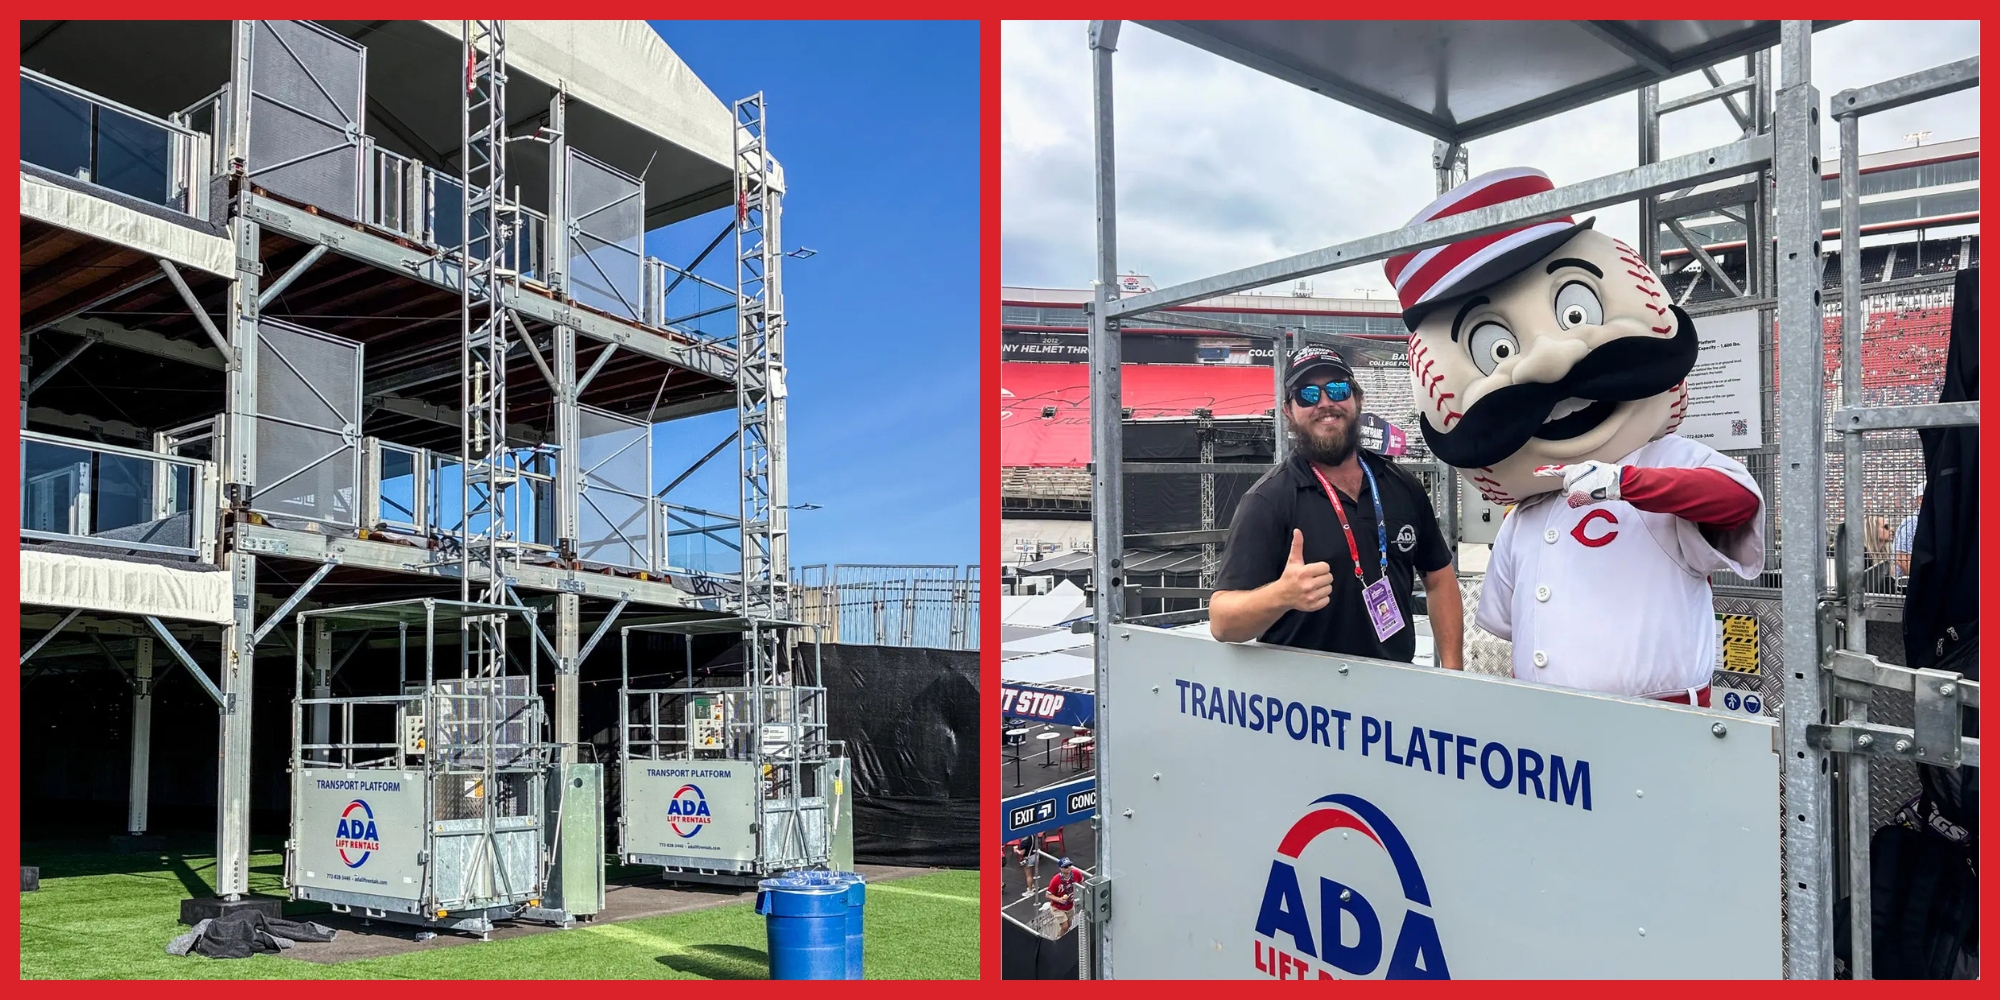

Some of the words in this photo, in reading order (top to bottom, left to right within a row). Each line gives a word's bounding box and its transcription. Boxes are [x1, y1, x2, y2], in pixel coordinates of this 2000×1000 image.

[1021, 345, 1064, 354] HELMET
[1397, 532, 1416, 542] ADA
[1570, 508, 1618, 548] C
[1016, 690, 1064, 718] STOP
[1176, 679, 1352, 751] TRANSPORT
[1361, 715, 1593, 812] PLATFORM
[647, 769, 689, 777] TRANSPORT
[691, 770, 731, 778] PLATFORM
[317, 780, 358, 790] TRANSPORT
[360, 781, 400, 792] PLATFORM
[667, 799, 711, 816] ADA
[1072, 792, 1096, 810] CONC
[1015, 808, 1035, 826] EXIT
[336, 819, 379, 841] ADA
[336, 840, 348, 848] LIFT
[350, 841, 379, 850] RENTALS
[1254, 860, 1452, 980] ADA
[1254, 940, 1311, 980] LIFT
